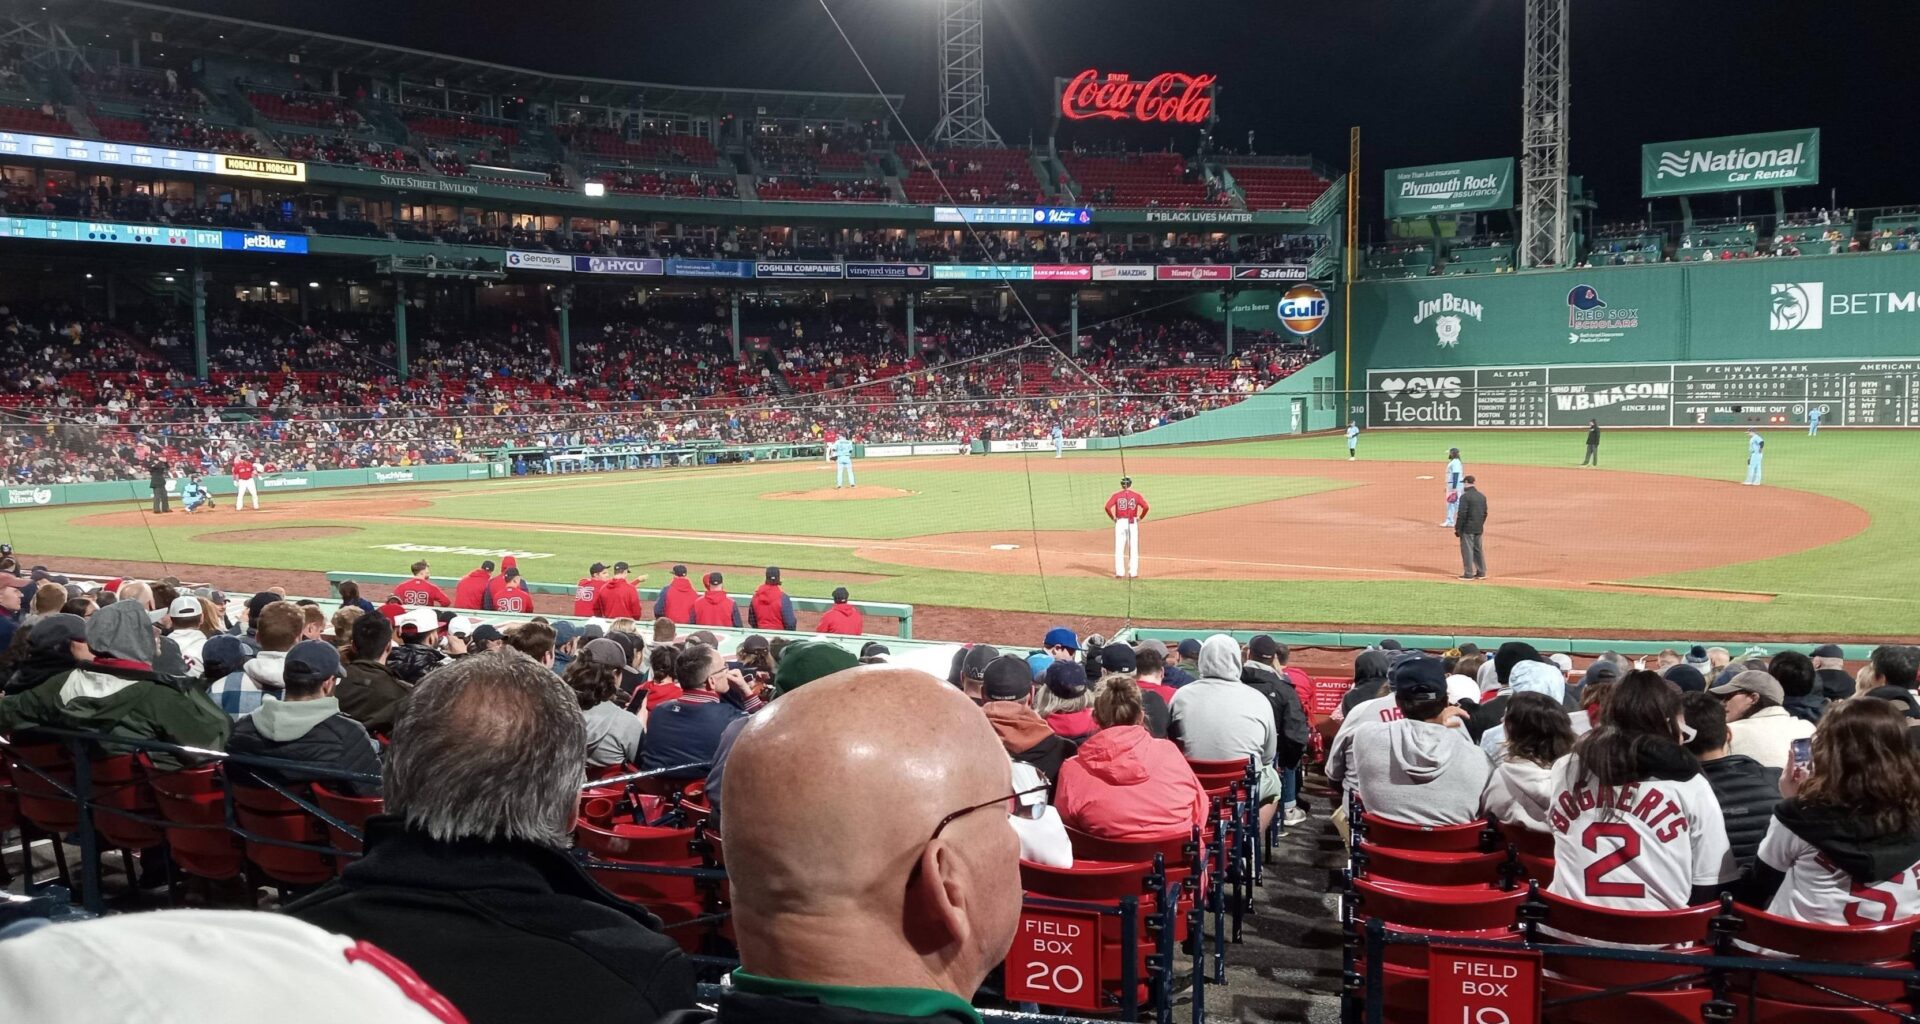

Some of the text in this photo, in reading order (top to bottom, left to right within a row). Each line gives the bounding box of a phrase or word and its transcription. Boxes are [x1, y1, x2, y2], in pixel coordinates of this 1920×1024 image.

[1063, 69, 1217, 122] Coca-Cola
[228, 159, 295, 174] MORGAN & MORGAN
[1728, 167, 1797, 182] Car Rental
[380, 175, 478, 194] STATE STREET PAVILION
[1401, 174, 1498, 196] Plymouth Rock
[1452, 188, 1498, 198] assurance
[1161, 213, 1252, 222] BLACK LIVES MATTER
[89, 224, 115, 233] BALL
[127, 226, 160, 235] STRIKE
[168, 229, 187, 237] OUT
[243, 234, 286, 249] jetBlue
[523, 254, 560, 264] Genasys
[608, 260, 643, 270] HYCU
[794, 265, 840, 273] COMPANIES
[850, 266, 905, 275] vineyard vines
[1260, 268, 1305, 278] Safelite
[1280, 300, 1325, 317] Gulf
[1414, 293, 1483, 324] JIM BEAM
[1830, 291, 1920, 314] BETM
[1576, 309, 1638, 320] RED SOX
[1575, 319, 1638, 329] SCHOLARS
[1407, 377, 1461, 399] CVS
[1351, 406, 1364, 414] 310
[1384, 401, 1462, 421] Health
[1697, 413, 1705, 423] 2
[404, 590, 429, 605] 39
[498, 598, 522, 612] 30
[1582, 822, 1645, 898] 2
[1026, 920, 1080, 937] FIELD
[1034, 939, 1072, 955] BOX
[1026, 961, 1083, 993] 20
[1453, 961, 1517, 978] FIELD
[1462, 981, 1508, 997] BOX
